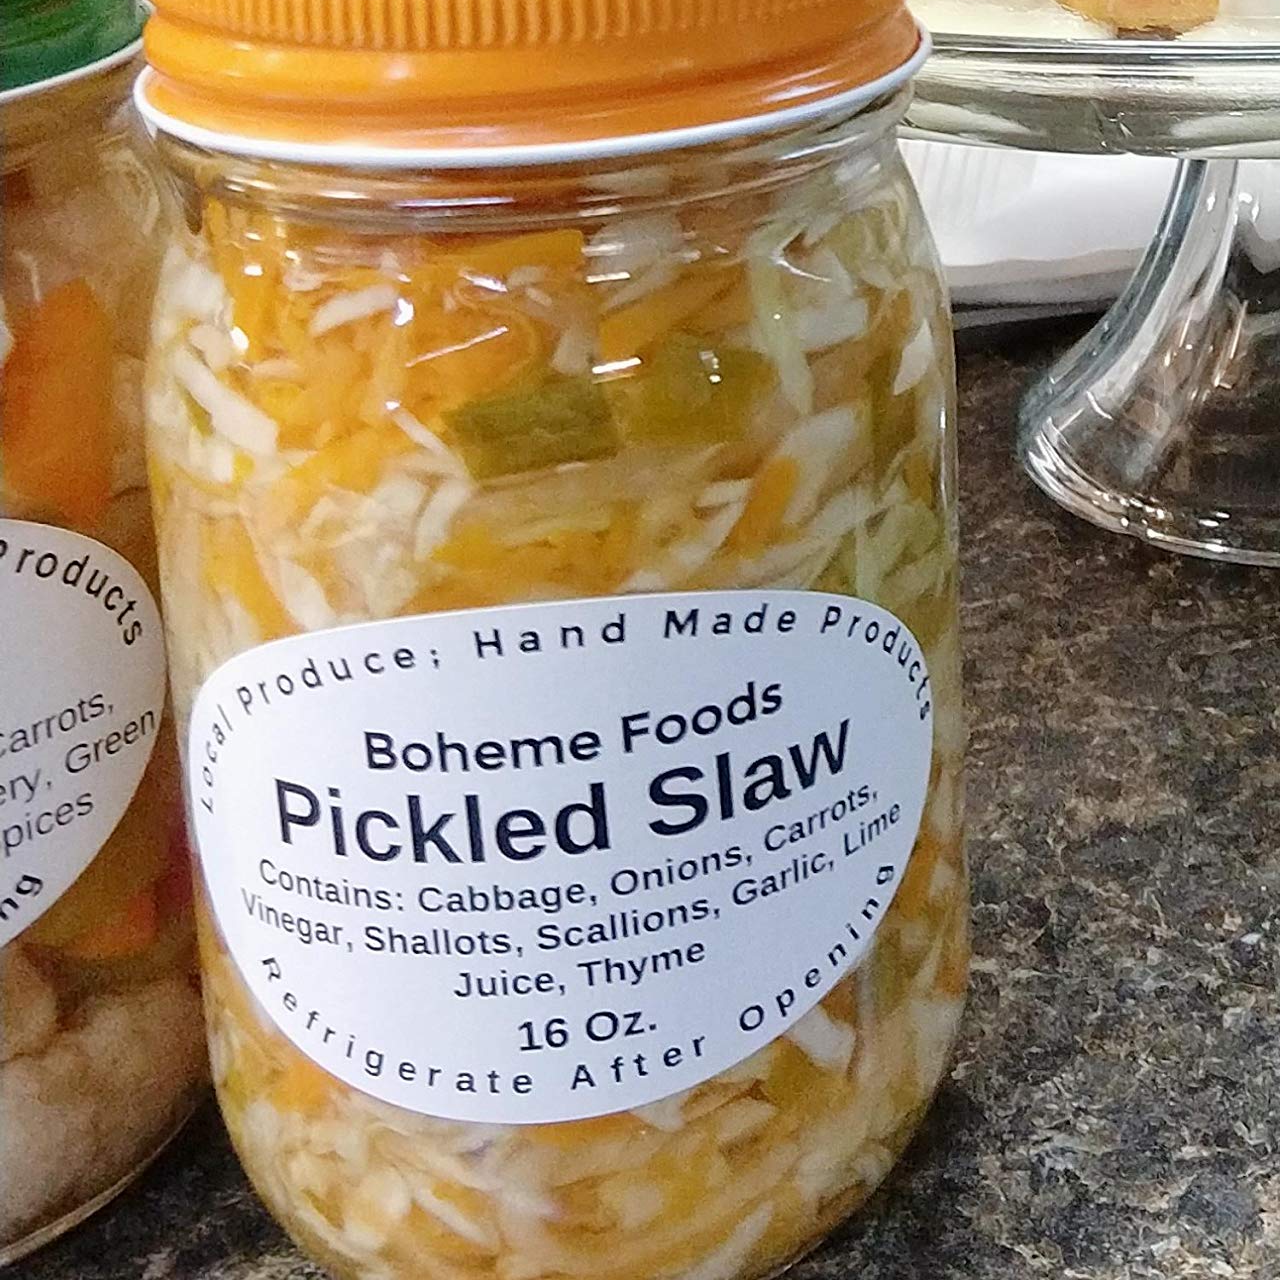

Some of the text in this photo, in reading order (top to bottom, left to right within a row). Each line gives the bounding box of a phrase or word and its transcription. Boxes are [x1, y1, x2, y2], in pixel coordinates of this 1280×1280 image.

[65, 710, 155, 773] Green
[200, 603, 930, 814] Local Produce; Hand Made Products
[364, 681, 783, 773] Boheme Foods
[259, 784, 878, 914] Contains: Cabbage, Onions, Carrots,
[274, 718, 850, 864] Pickled Slaw
[240, 801, 901, 958] Vinegar, Shallots, Scallions, Garlic, Lime
[262, 864, 895, 1094] Refrigerate After Opening
[454, 941, 706, 997] Juice, Thyme
[518, 1011, 657, 1051] 16 Oz.
